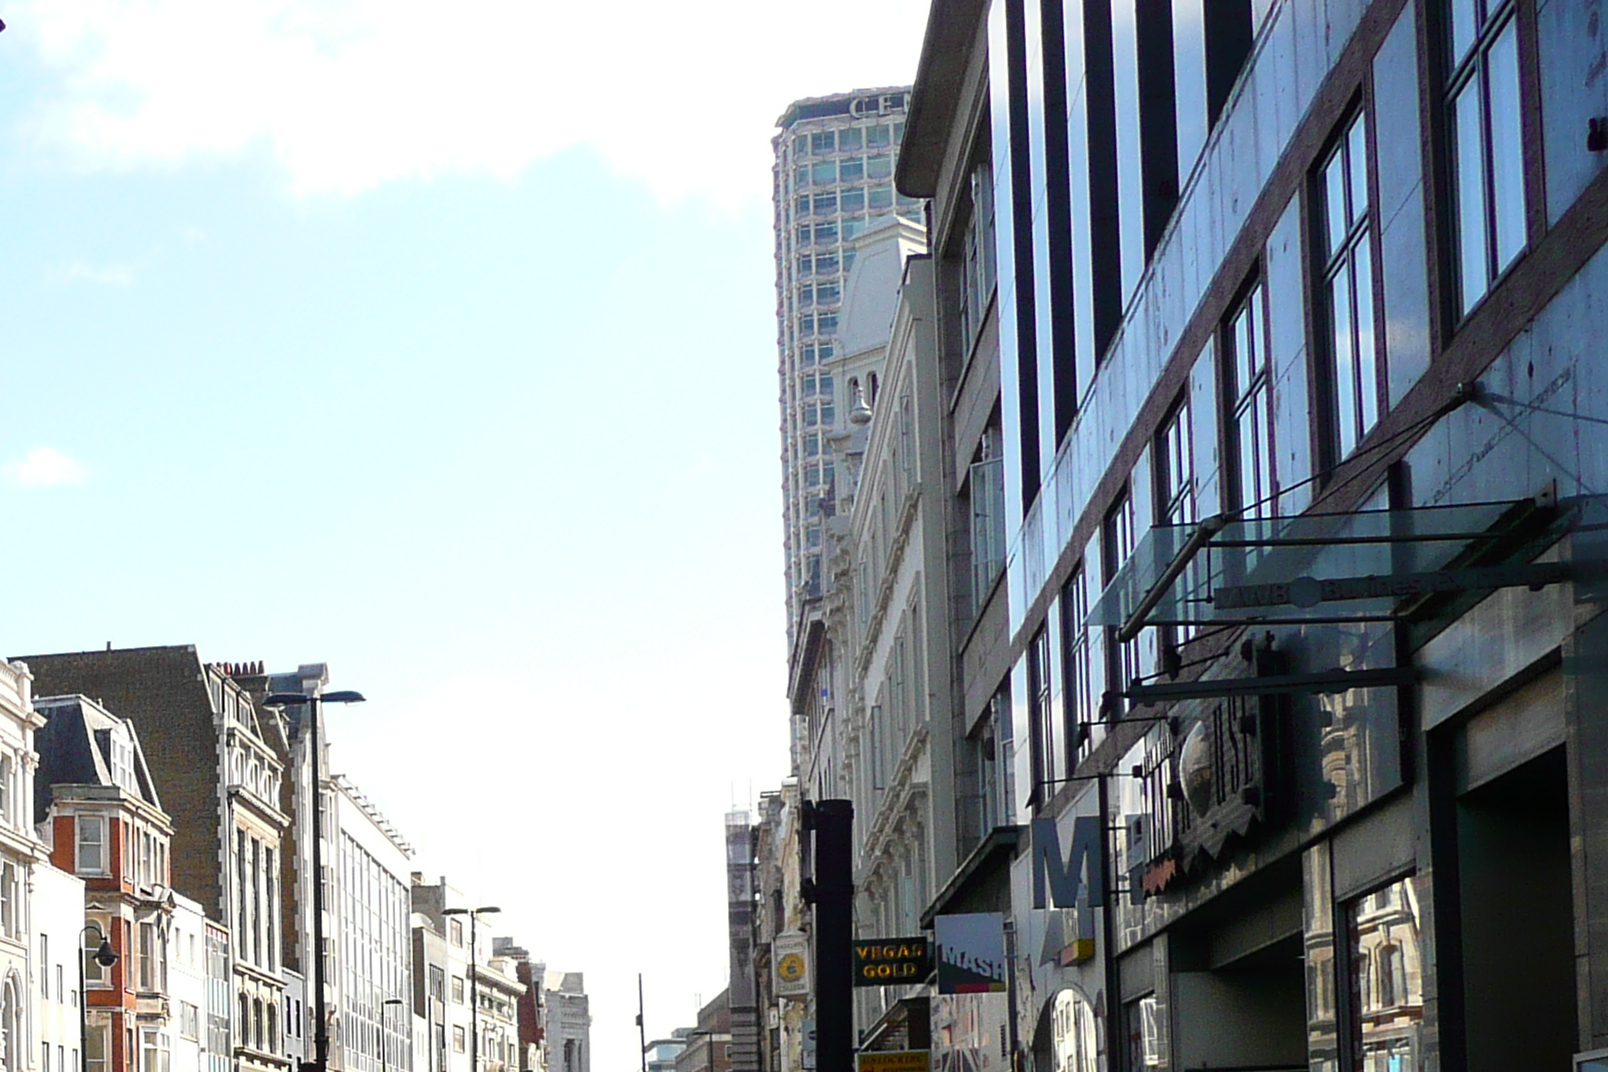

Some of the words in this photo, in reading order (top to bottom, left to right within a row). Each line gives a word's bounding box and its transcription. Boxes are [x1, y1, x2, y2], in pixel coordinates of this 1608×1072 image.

[856, 943, 925, 960] VEGAS
[863, 962, 919, 980] GOLD
[941, 945, 1005, 981] MASH
